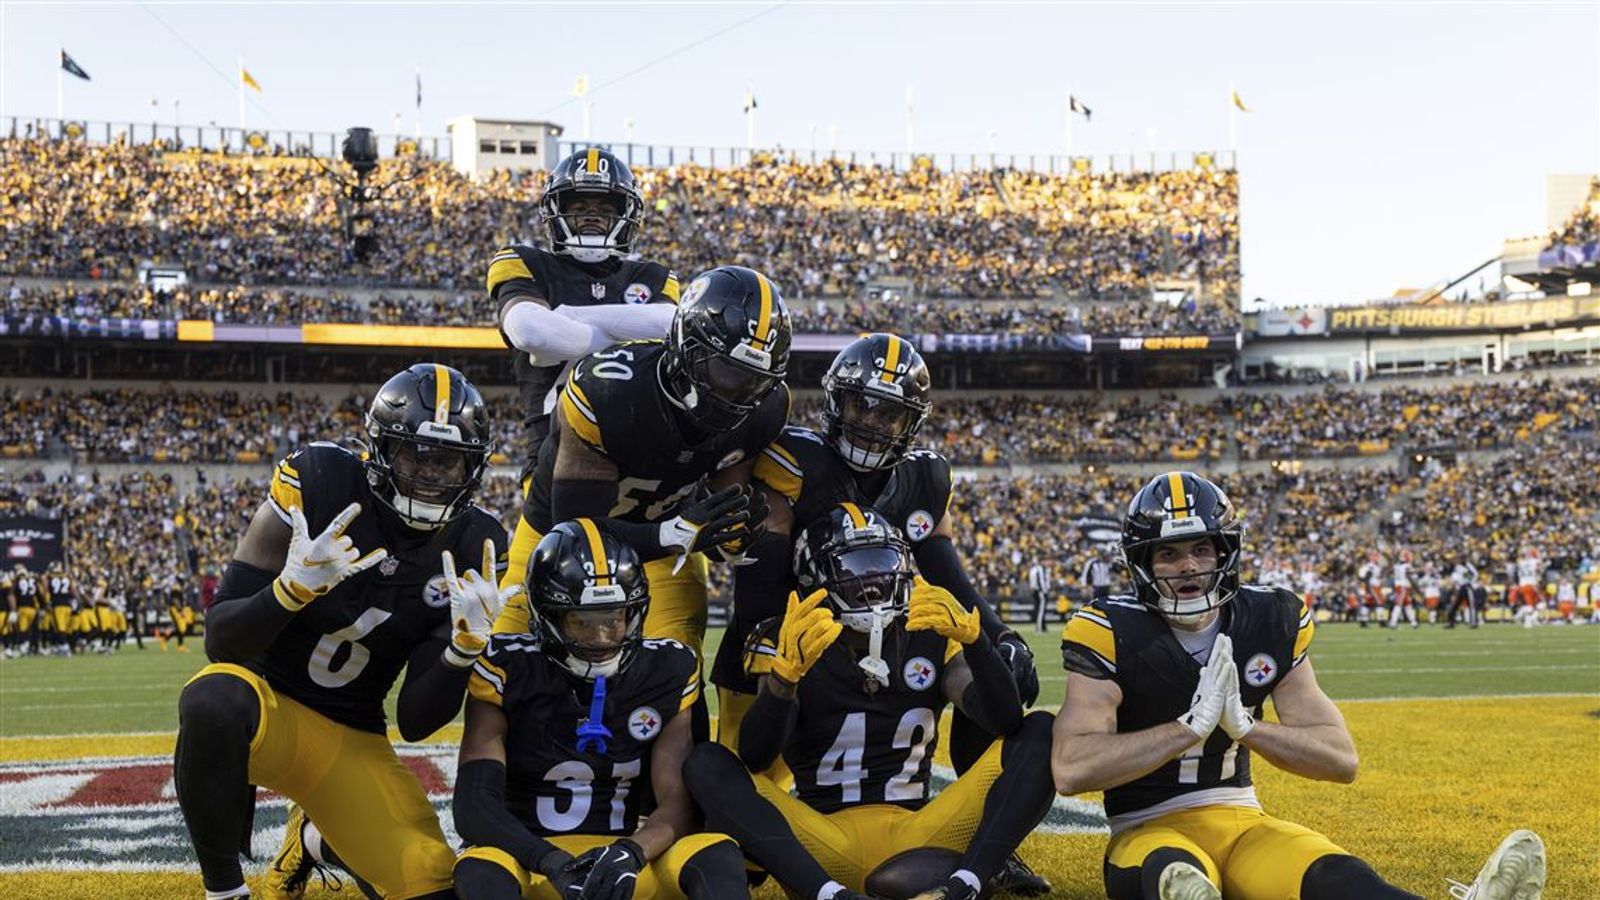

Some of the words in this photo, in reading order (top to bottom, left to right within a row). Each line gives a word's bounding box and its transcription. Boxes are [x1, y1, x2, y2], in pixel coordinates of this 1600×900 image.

[576, 158, 609, 173] 20
[1331, 304, 1463, 329] PITTSBURGH
[1466, 299, 1574, 326] STEELERS
[435, 399, 449, 428] 6
[51, 577, 70, 594] 92
[583, 559, 617, 587] 31
[308, 606, 393, 688] 6
[816, 707, 936, 803] 42
[536, 758, 641, 832] 31
